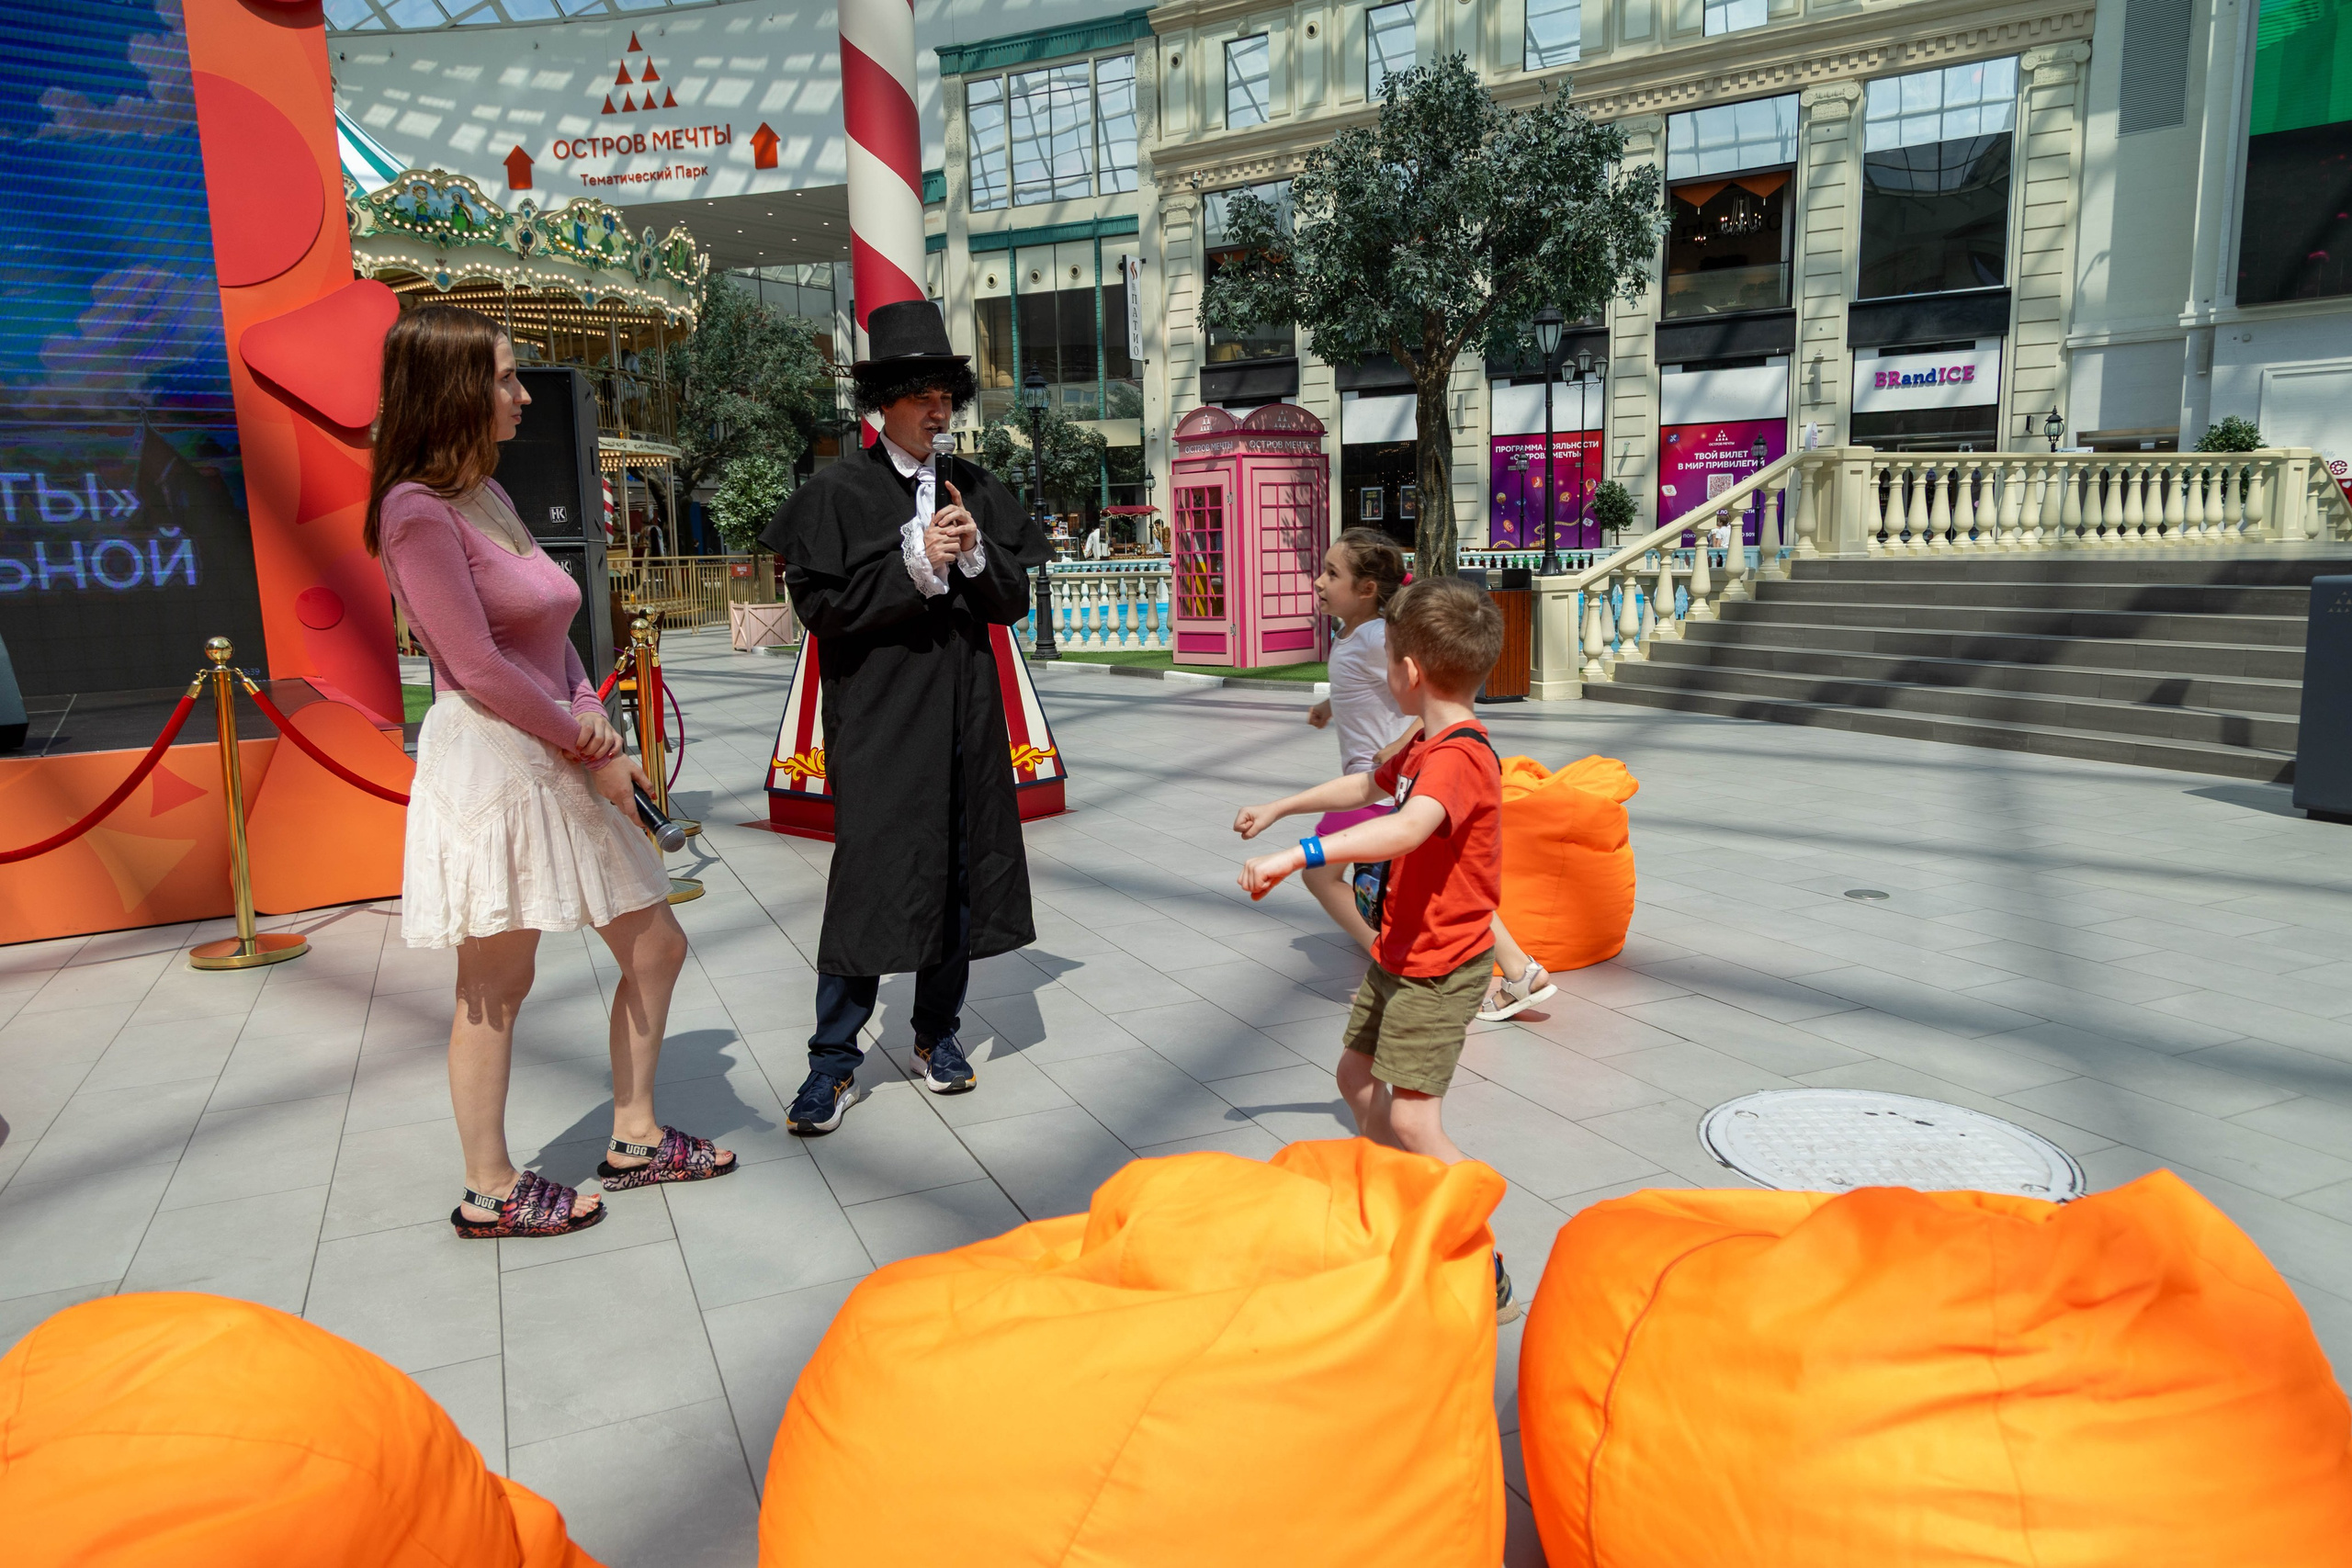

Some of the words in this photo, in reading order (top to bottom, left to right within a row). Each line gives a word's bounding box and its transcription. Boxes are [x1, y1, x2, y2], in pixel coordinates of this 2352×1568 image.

[553, 133, 647, 160] ОСТРОВ
[652, 123, 732, 152] МЕЧТЫ
[581, 166, 673, 186] Тематический
[675, 165, 708, 181] Парк
[1131, 294, 1139, 356] ПАТИО
[1875, 365, 1975, 387] BRandICE
[1184, 445, 1210, 454] ОСТРОВ
[1211, 441, 1233, 451] МЕЧТЫ
[1249, 440, 1283, 449] ОСТРОВ
[1285, 441, 1314, 450] МЕЧТЫ
[1495, 444, 1543, 453] ПРОГРАММА
[1544, 441, 1600, 451] ЯЛЬНОСТИ
[1694, 450, 1718, 460] ТВОЙ
[1719, 450, 1748, 459] БИЛЕТ
[551, 508, 565, 520] HK
[626, 1144, 648, 1156] UGG
[474, 1195, 496, 1210] UGG
